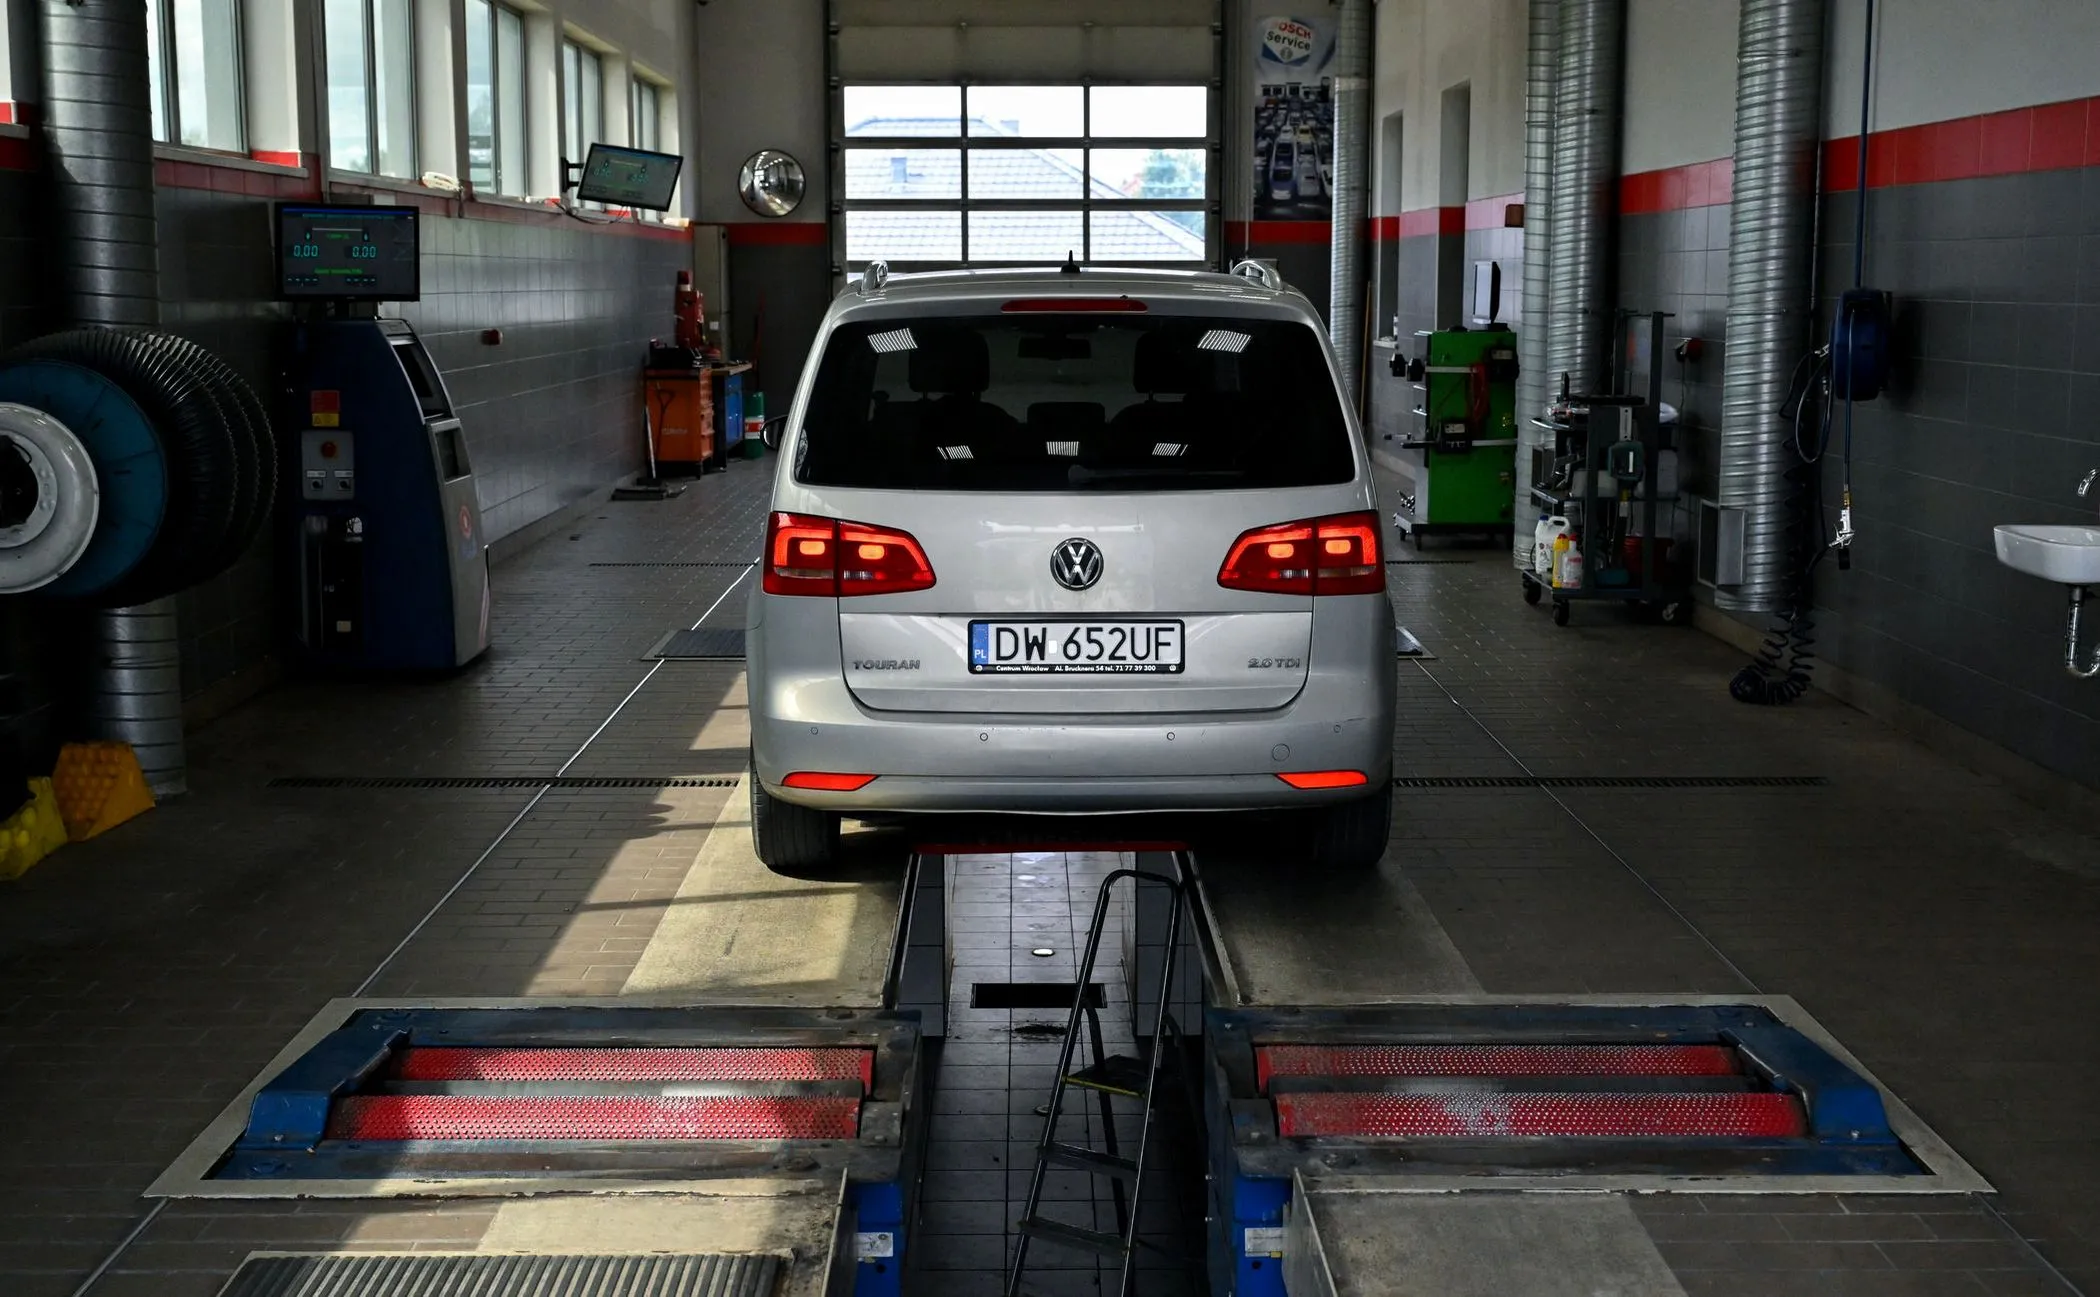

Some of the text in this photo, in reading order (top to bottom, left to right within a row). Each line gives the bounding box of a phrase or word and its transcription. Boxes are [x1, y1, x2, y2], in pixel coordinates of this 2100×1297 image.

[1272, 21, 1312, 40] OSCH
[1266, 30, 1311, 51] Service
[996, 627, 1175, 661] DW 652UF
[974, 649, 987, 659] PL
[853, 659, 921, 670] TOURAN
[1247, 658, 1301, 669] 2.0 TDI
